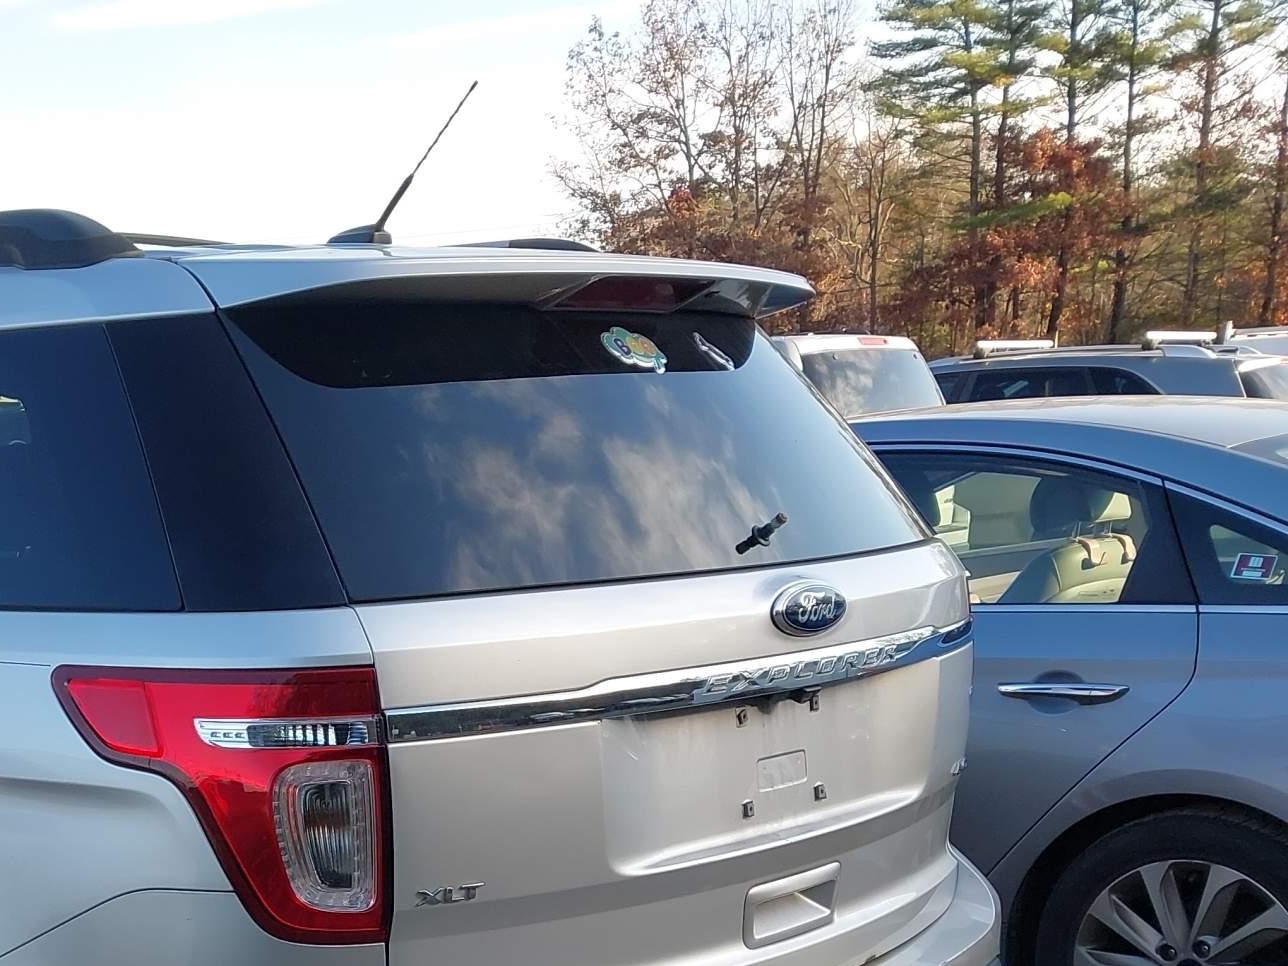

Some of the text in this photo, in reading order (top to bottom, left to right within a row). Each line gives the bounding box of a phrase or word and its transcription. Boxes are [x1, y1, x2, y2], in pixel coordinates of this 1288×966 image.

[798, 591, 837, 623] Ford
[703, 645, 898, 694] EXPLORER
[415, 882, 485, 907] XLT
